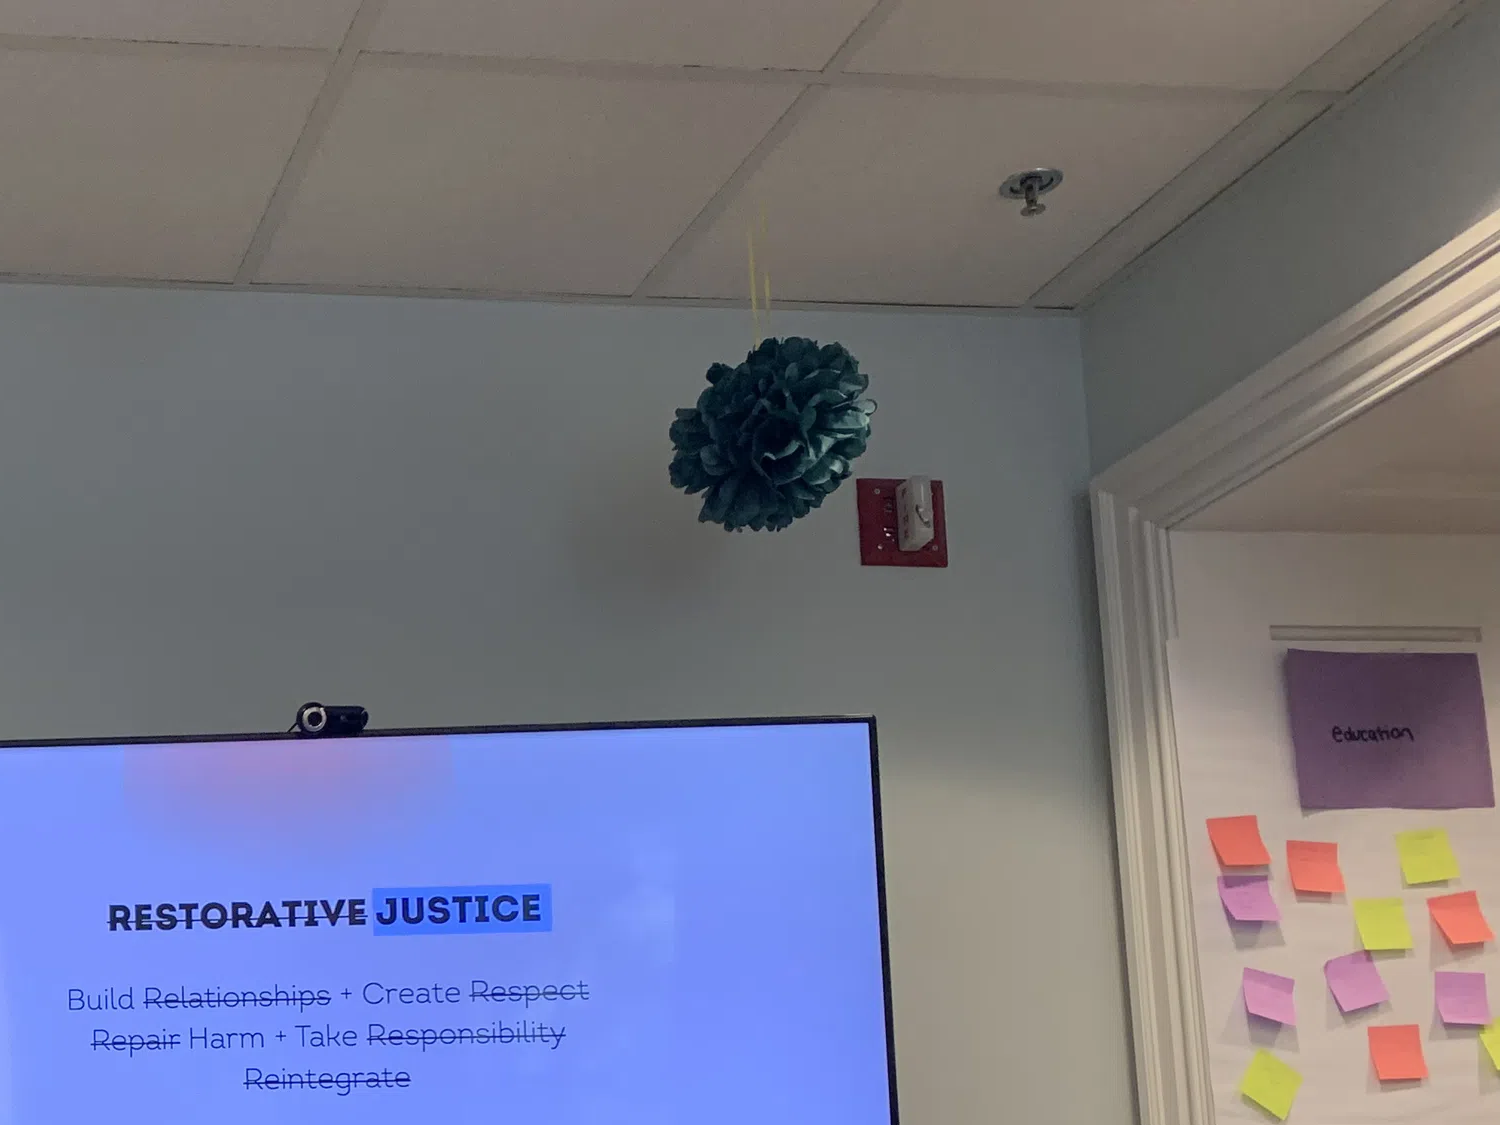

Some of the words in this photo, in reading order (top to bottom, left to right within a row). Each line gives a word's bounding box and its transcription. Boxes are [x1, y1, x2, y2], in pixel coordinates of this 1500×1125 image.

[1331, 725, 1415, 743] education
[107, 898, 367, 932] RESTORATIVE
[376, 893, 542, 925] JUSTICE
[67, 985, 135, 1011] Build
[143, 984, 332, 1014] Relationships
[341, 986, 352, 1000] +
[362, 981, 461, 1006] Create
[469, 979, 590, 1009] Respect
[91, 1026, 181, 1056] Repair
[189, 1026, 265, 1050] Harm
[275, 1030, 287, 1043] +
[295, 1023, 358, 1048] Take
[367, 1019, 567, 1051] Responsibility
[243, 1066, 411, 1096] Reintegrate
